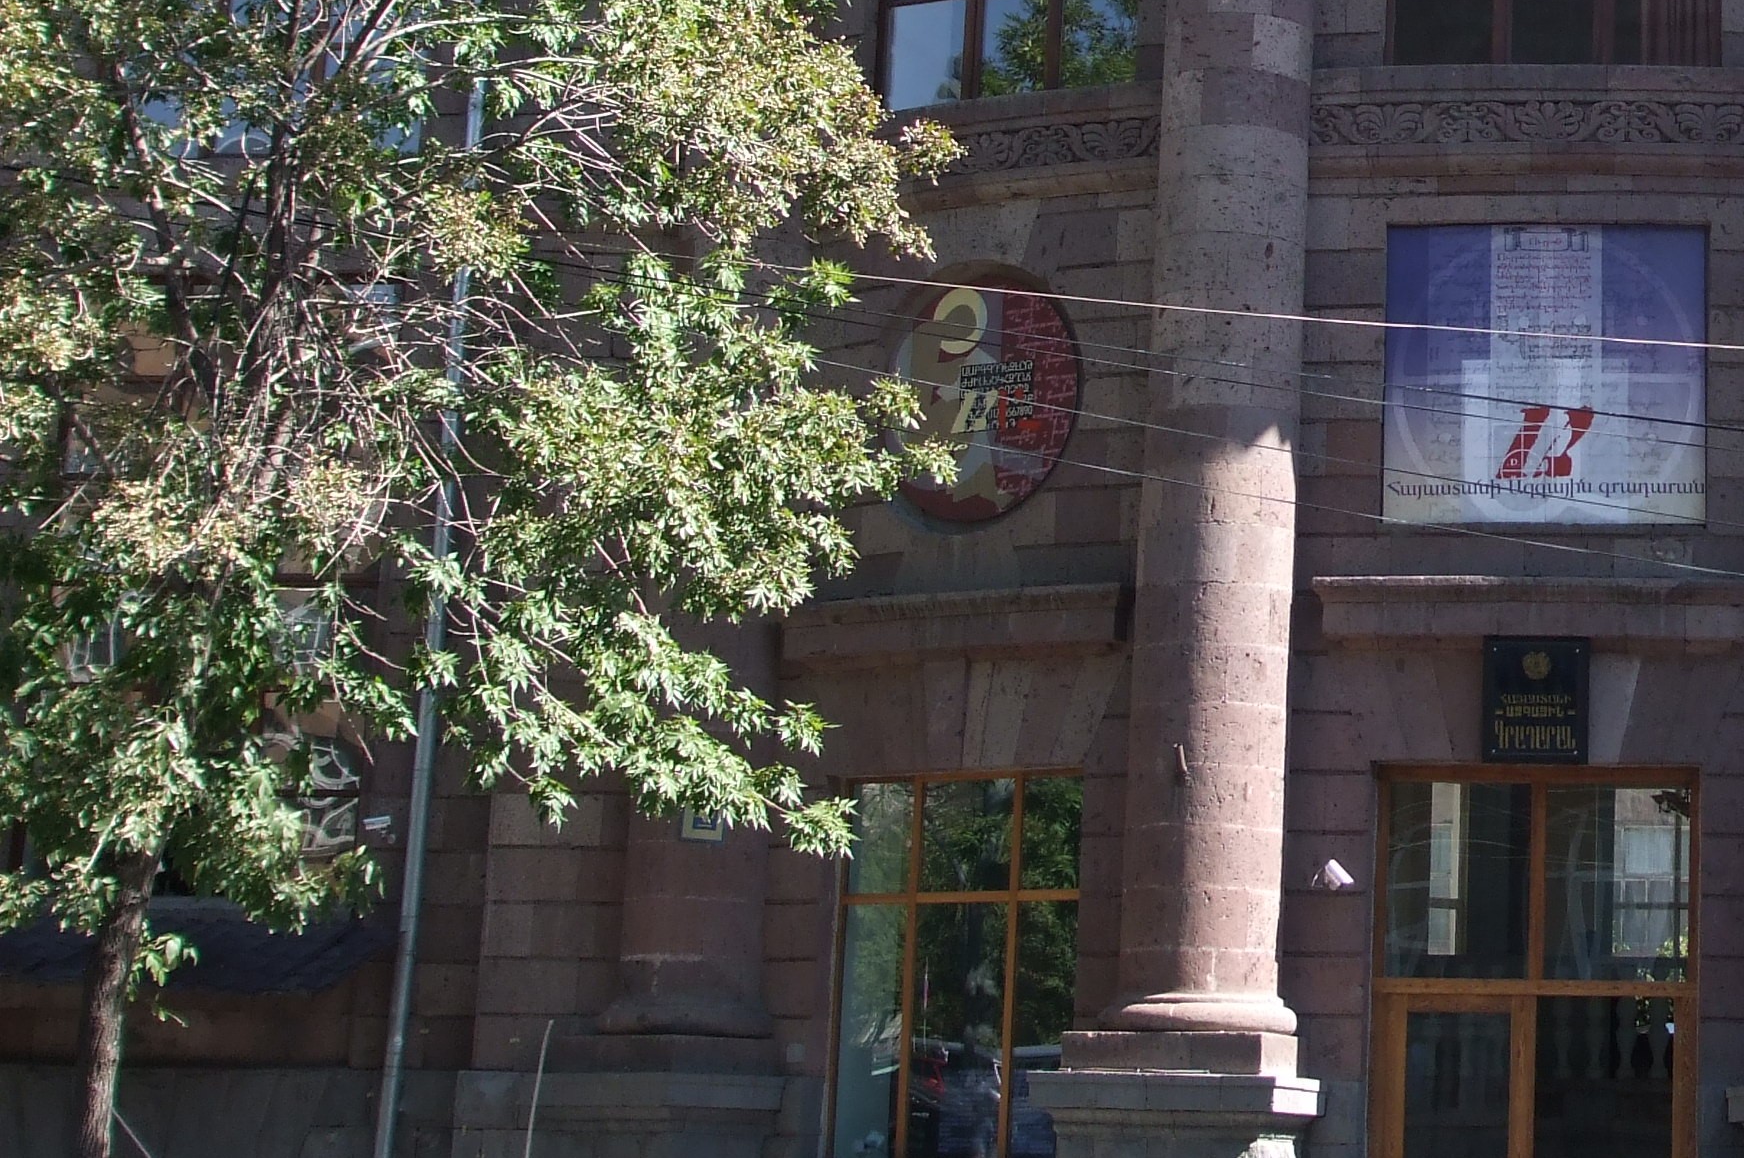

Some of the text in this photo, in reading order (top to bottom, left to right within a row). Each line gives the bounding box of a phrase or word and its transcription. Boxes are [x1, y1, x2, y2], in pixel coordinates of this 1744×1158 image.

[1387, 478, 1705, 499] Հայաստանի Ազգային գրադարան
